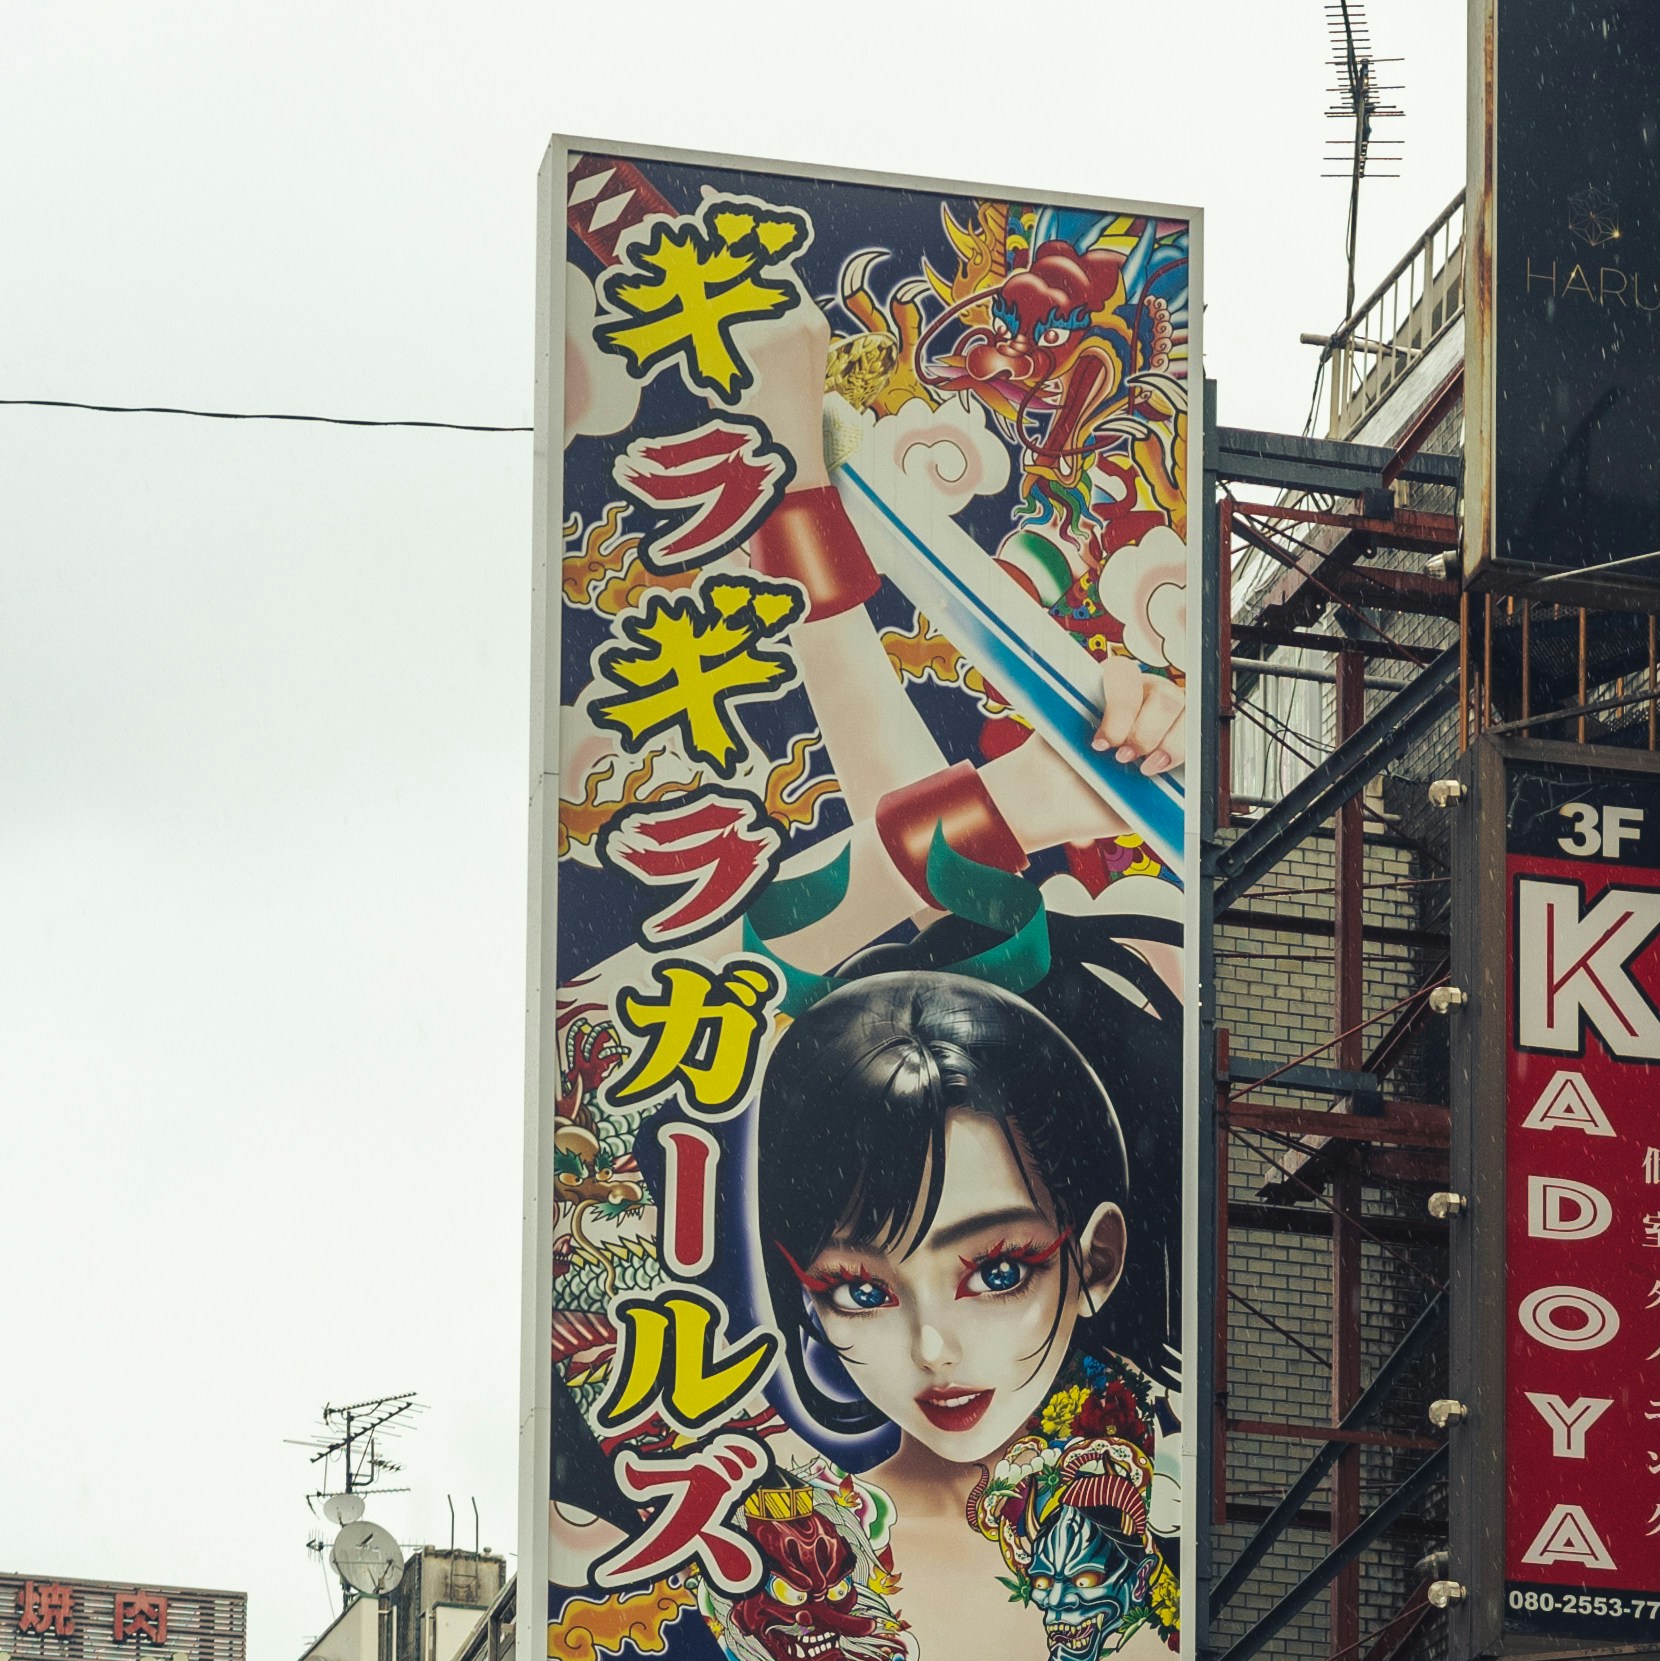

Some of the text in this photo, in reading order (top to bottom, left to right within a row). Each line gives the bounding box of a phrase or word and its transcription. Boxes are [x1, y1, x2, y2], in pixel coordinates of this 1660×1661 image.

[1557, 801, 1644, 859] 3F
[592, 203, 810, 1595] ギラギラガールズ
[17, 1580, 169, 1645] 焼肉
